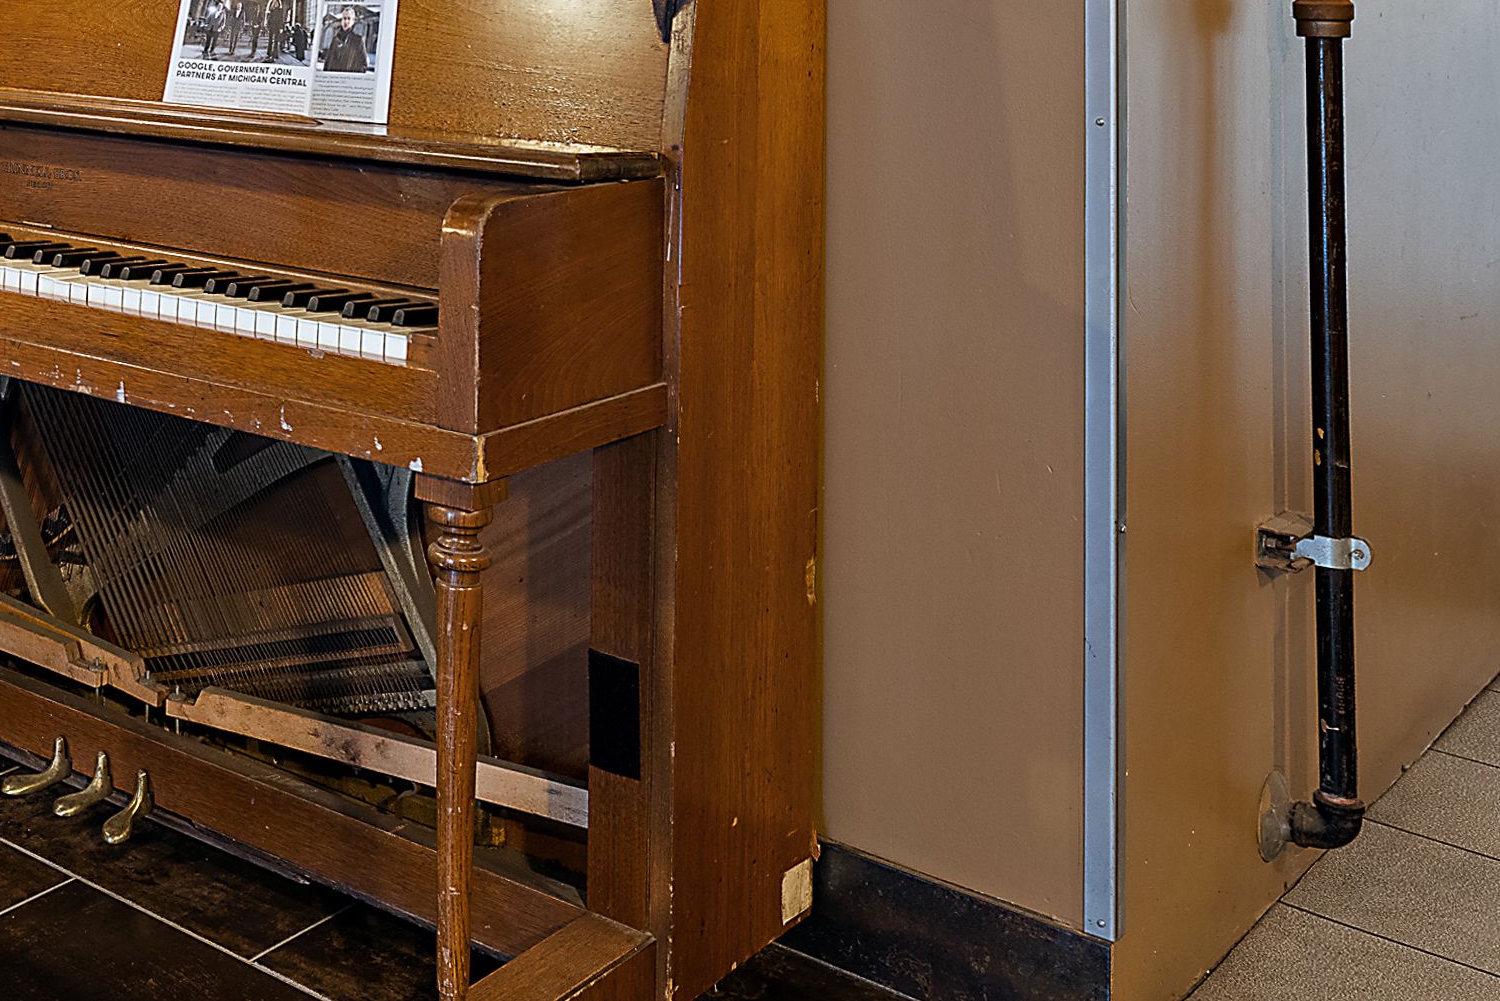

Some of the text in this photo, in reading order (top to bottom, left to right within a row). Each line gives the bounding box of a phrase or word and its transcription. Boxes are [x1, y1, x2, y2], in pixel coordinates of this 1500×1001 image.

[177, 61, 292, 76] GOOGLE, GOVERNMENT JOIN
[176, 70, 308, 87] PARTNERS AT MICHIGAN CENTRAL
